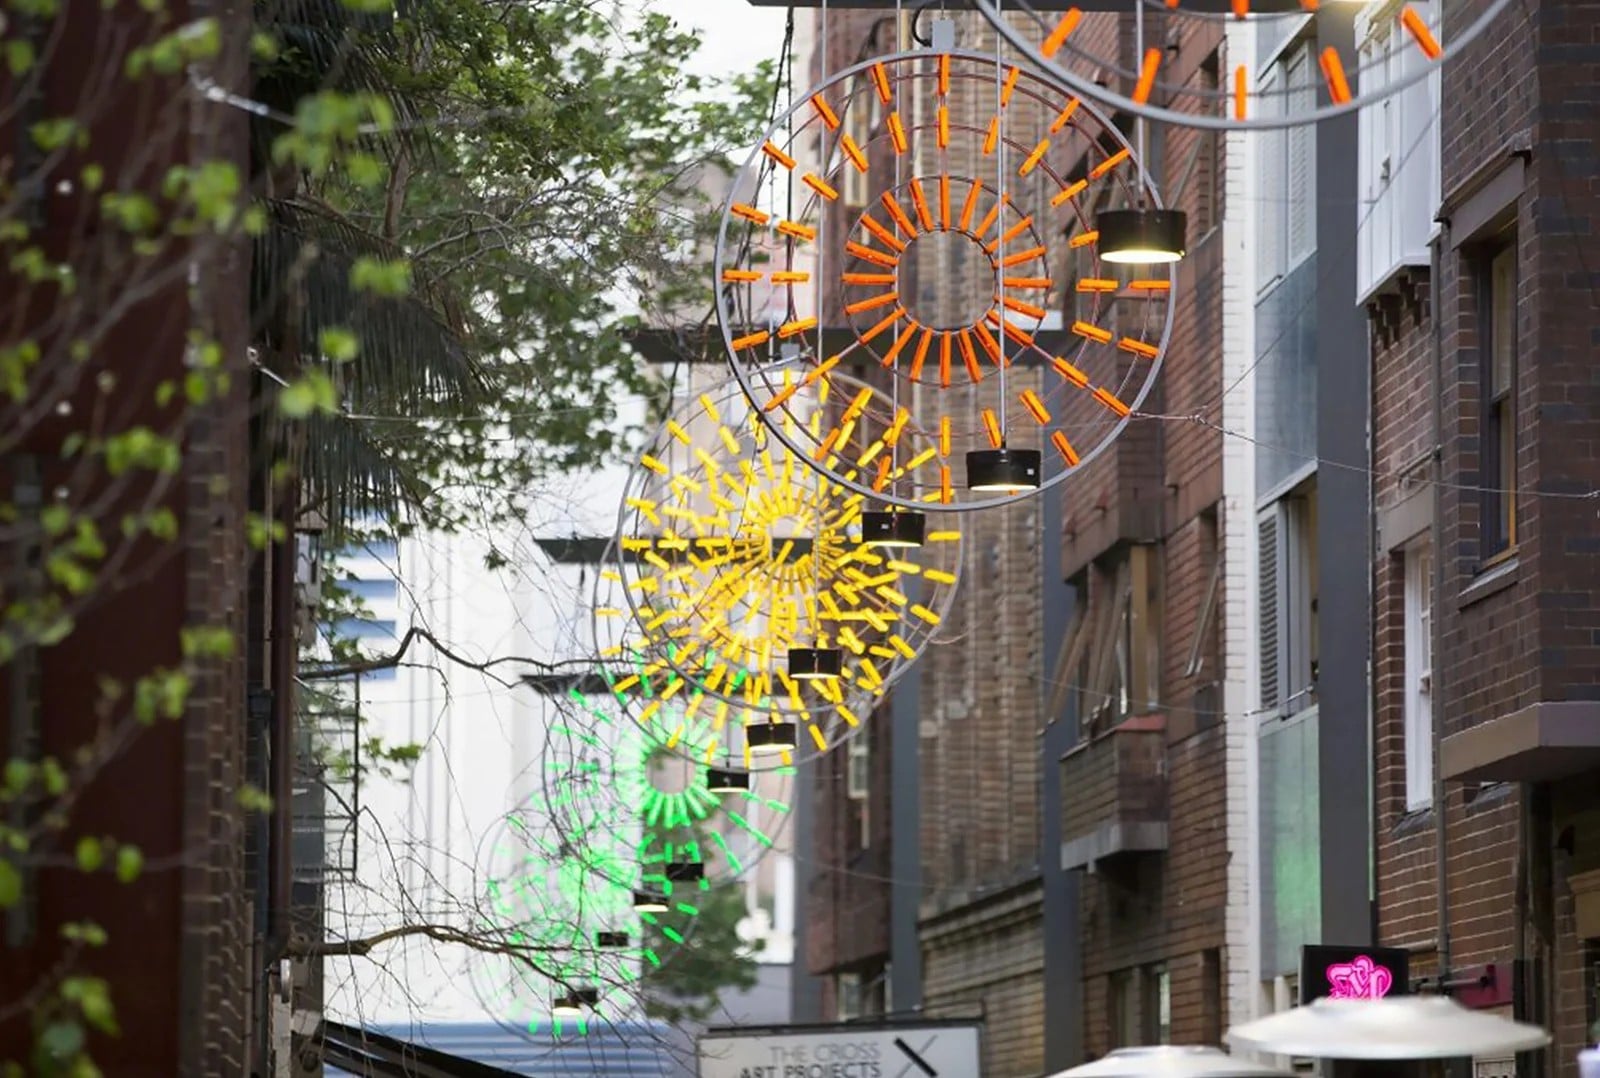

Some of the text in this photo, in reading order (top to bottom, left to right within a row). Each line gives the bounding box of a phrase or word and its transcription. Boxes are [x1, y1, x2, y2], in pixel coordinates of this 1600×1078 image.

[769, 1042, 882, 1063] THE CROSS
[740, 1062, 882, 1078] ART PROJECTS
